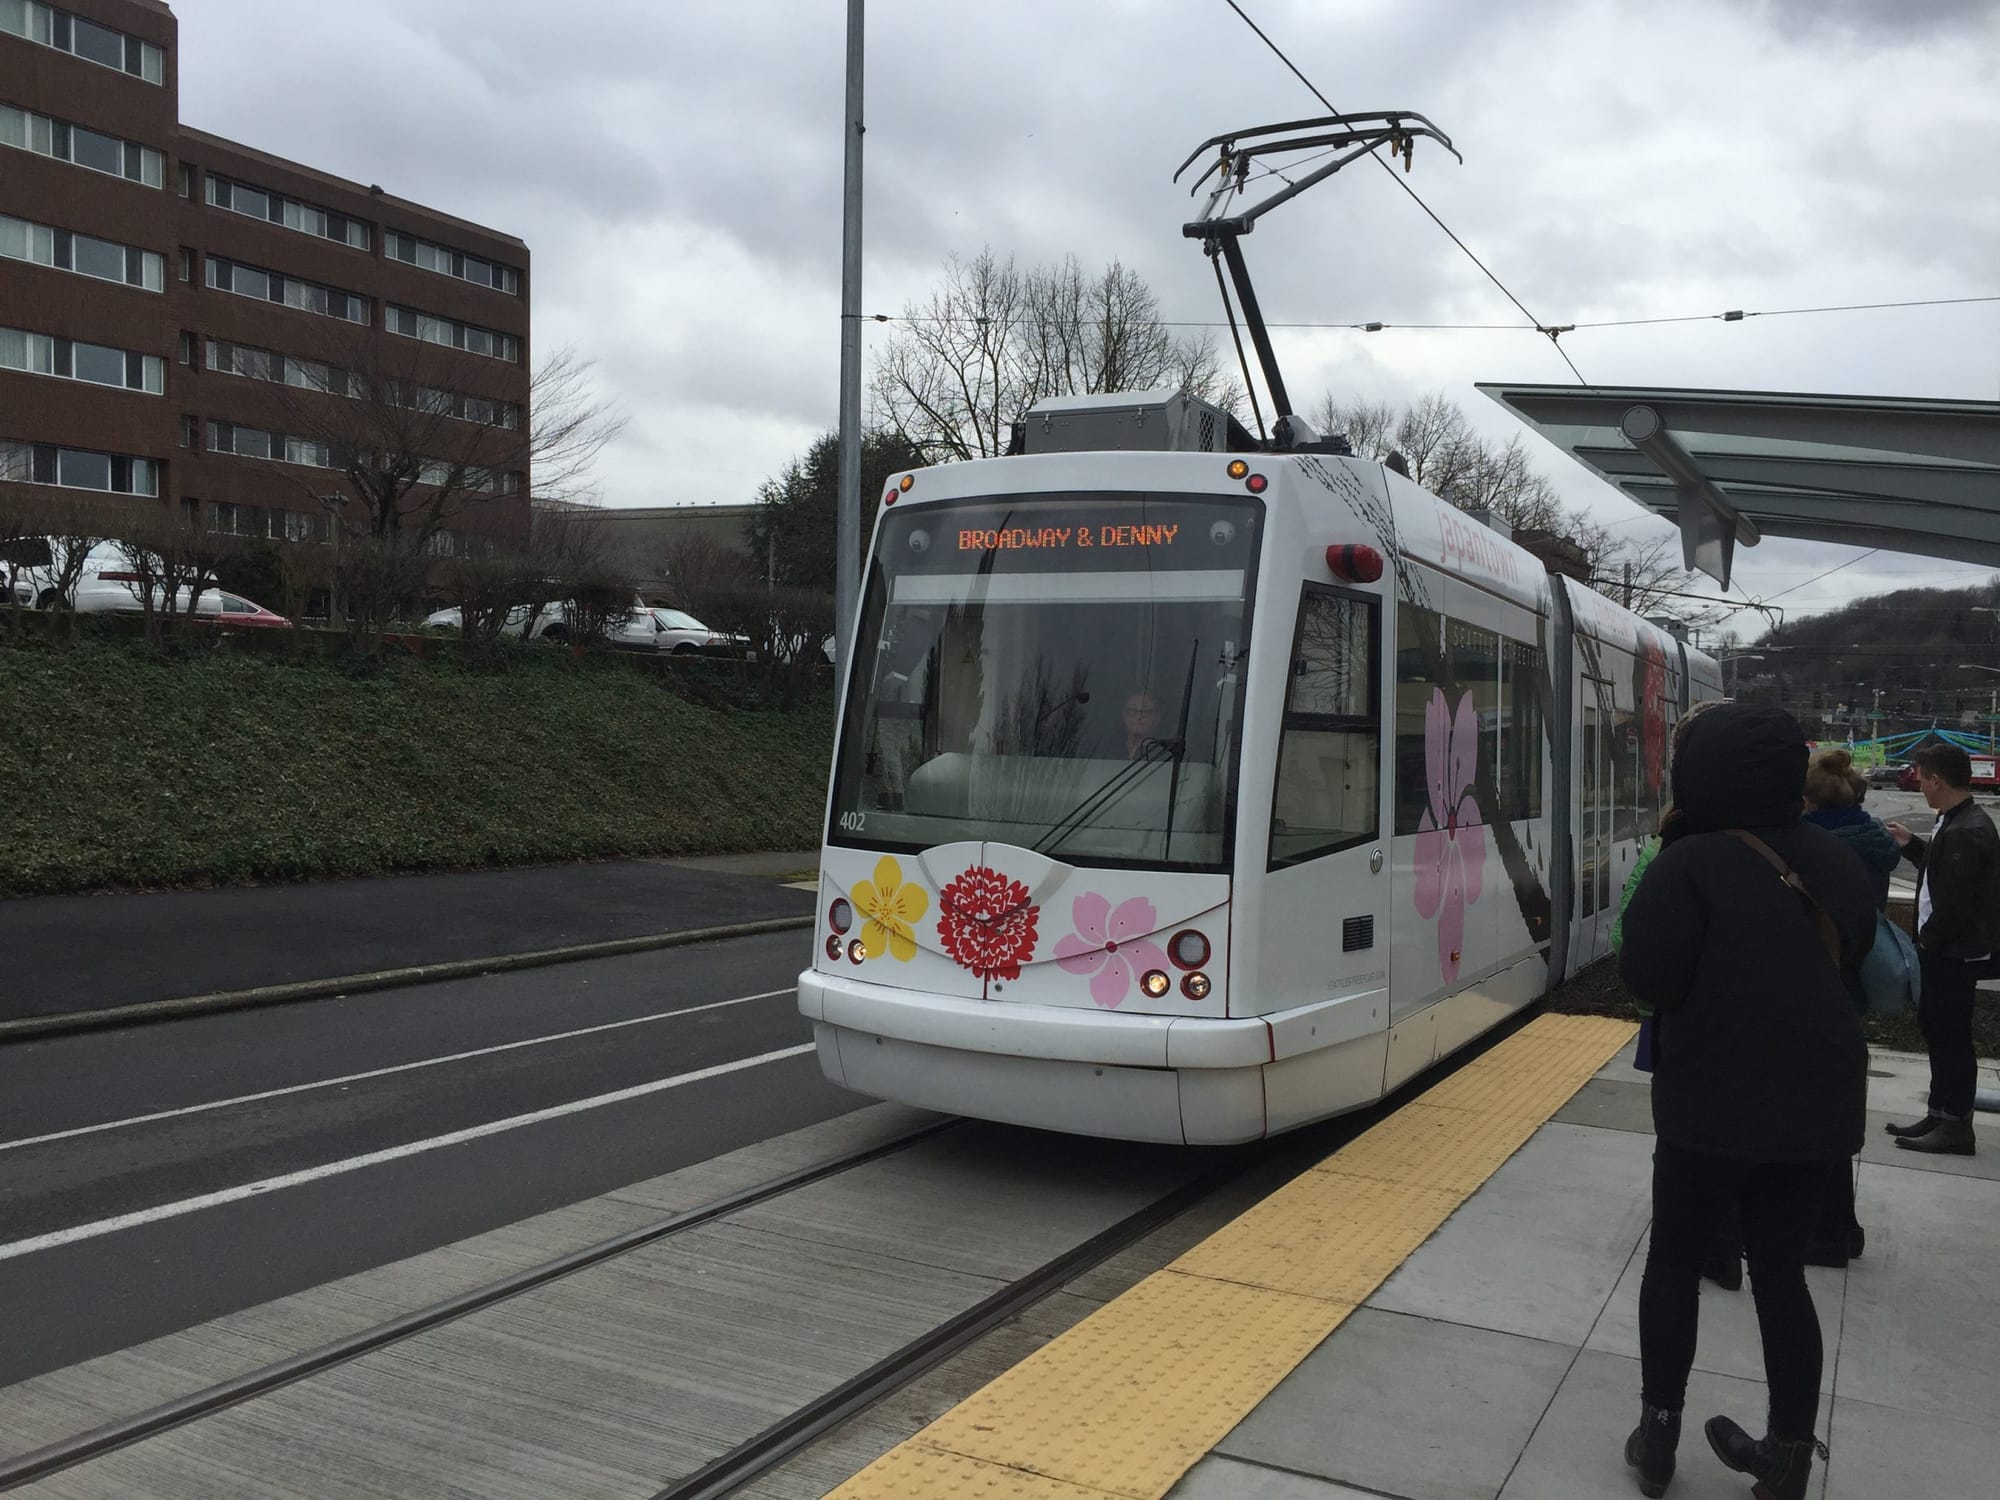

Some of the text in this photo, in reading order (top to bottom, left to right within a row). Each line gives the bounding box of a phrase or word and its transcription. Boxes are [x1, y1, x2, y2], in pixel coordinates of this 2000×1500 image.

[958, 524, 1178, 549] BROADWAY & DENNY
[1434, 504, 1519, 584] japantown
[1454, 624, 1494, 657] SEATTLE
[839, 811, 866, 832] 402
